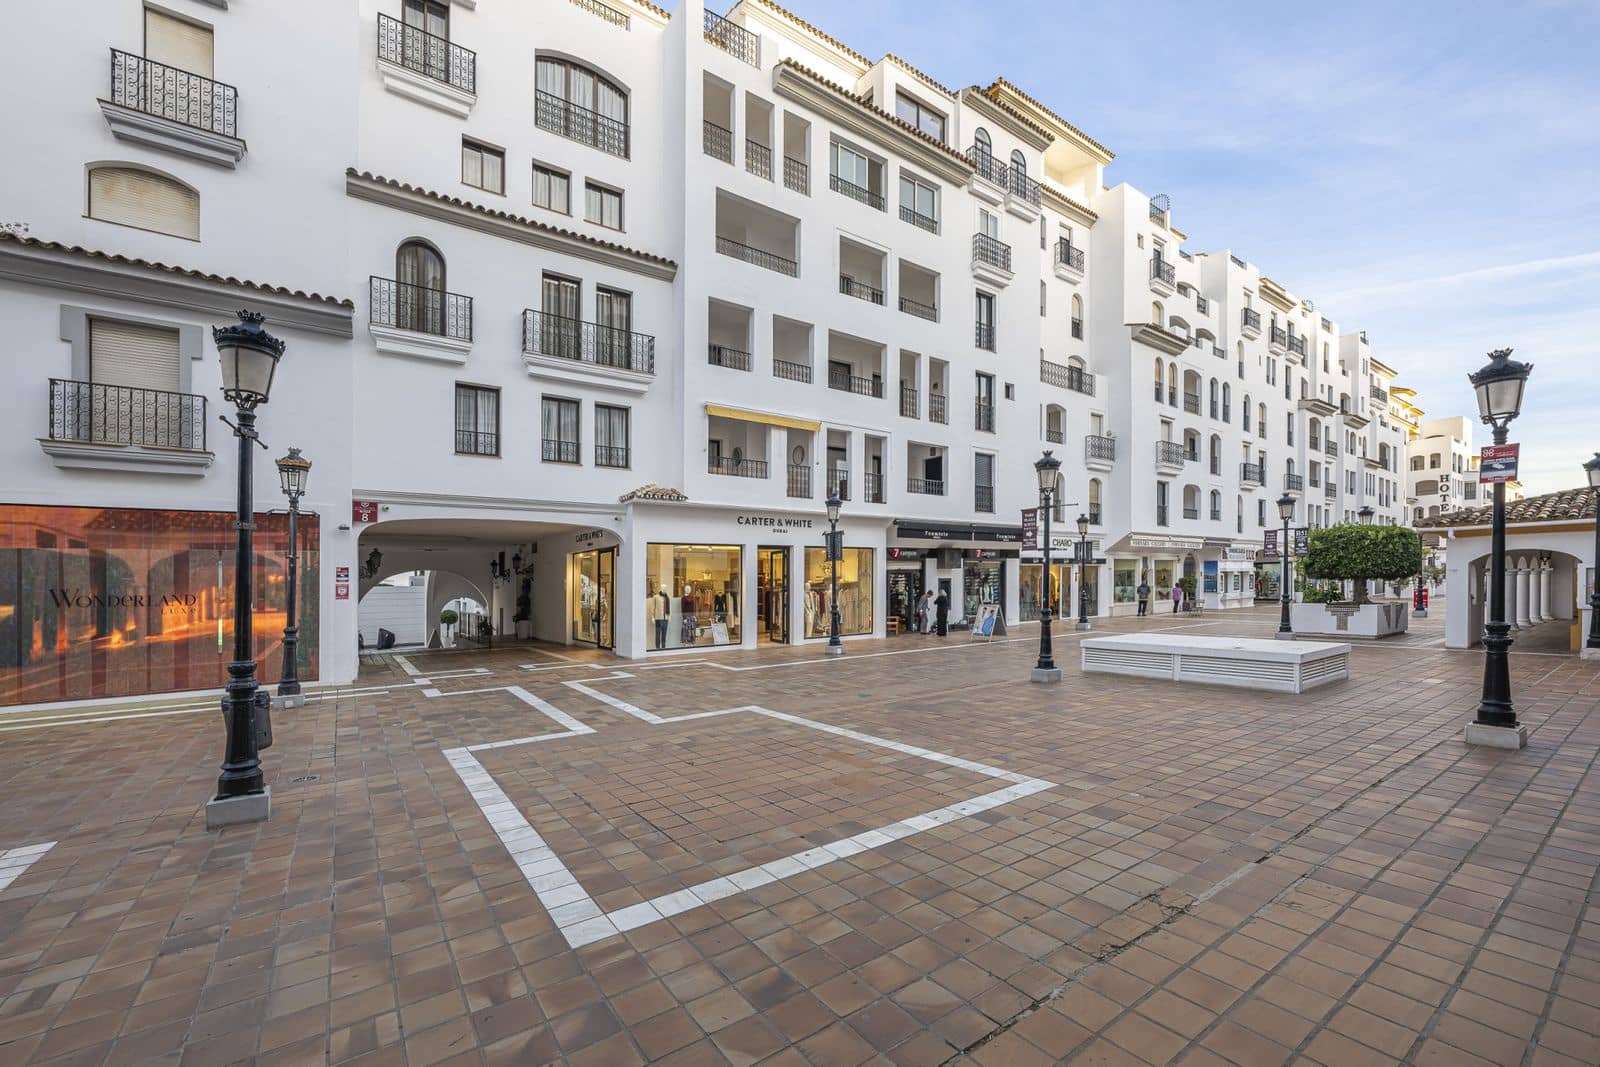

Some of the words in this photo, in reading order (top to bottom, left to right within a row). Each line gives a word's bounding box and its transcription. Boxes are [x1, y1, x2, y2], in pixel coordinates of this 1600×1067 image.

[1440, 474, 1450, 512] HOTE
[361, 513, 369, 521] 8
[737, 516, 775, 527] CARTER
[777, 518, 784, 527] &
[785, 519, 813, 528] WHITE
